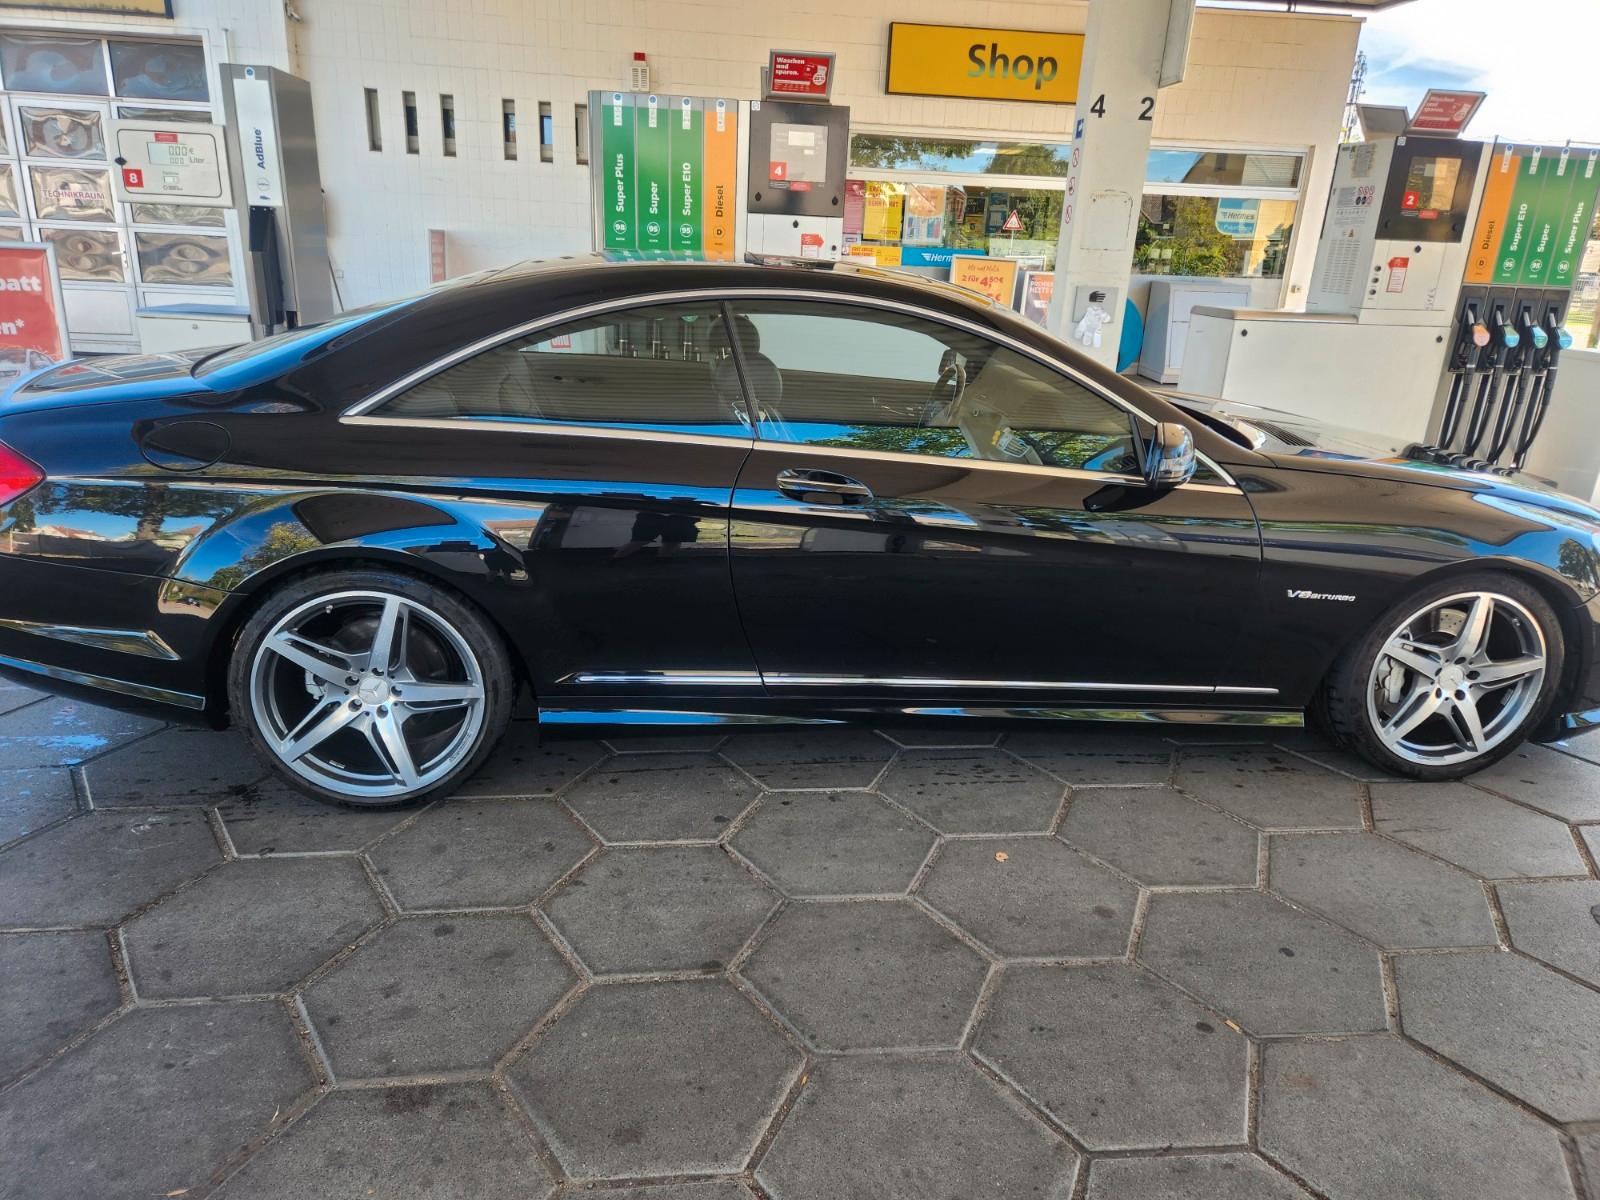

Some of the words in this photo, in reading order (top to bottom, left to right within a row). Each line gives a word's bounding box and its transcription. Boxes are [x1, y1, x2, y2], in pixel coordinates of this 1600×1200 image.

[968, 43, 1058, 90] Shop
[1090, 94, 1106, 119] 4
[1138, 96, 1155, 121] 2
[255, 129, 266, 170] AdBlue
[129, 172, 139, 184] 8
[615, 153, 624, 178] Plus
[682, 162, 692, 182] E10
[774, 165, 784, 177] 4
[42, 189, 105, 201] TECHNIKRAUM
[616, 179, 626, 213] Super
[650, 182, 660, 215] Super
[682, 183, 693, 216] Super
[715, 185, 724, 218] Diesel
[1406, 195, 1416, 206] 2
[1482, 220, 1496, 250] Diesel
[1510, 222, 1524, 252] Super
[1517, 203, 1528, 222] E10
[1537, 224, 1551, 253] Super
[1564, 225, 1579, 254] Super
[1572, 202, 1585, 224] Plus
